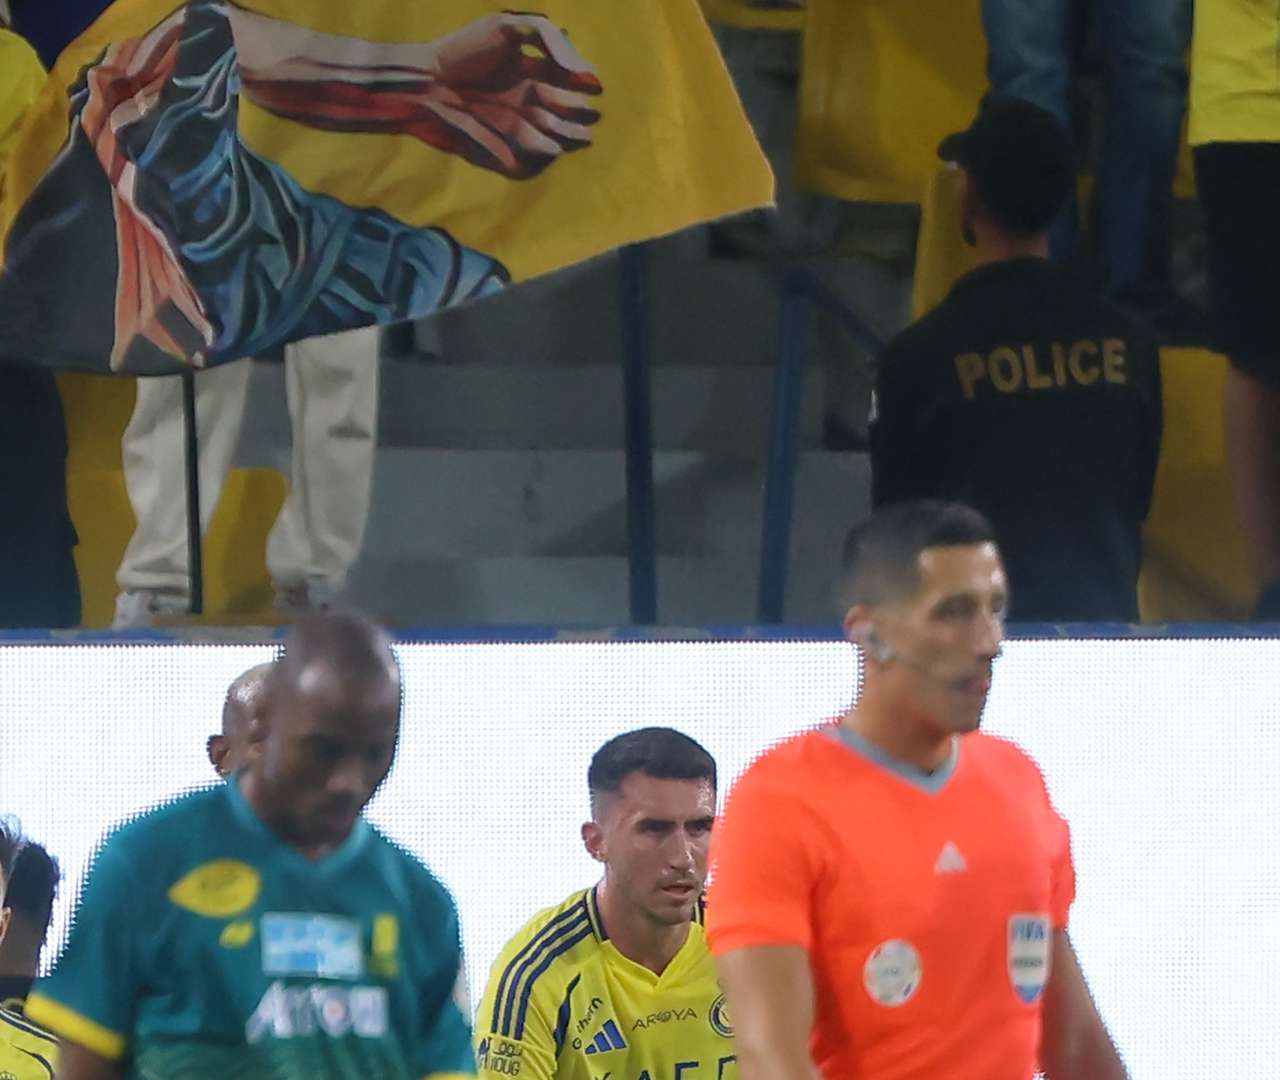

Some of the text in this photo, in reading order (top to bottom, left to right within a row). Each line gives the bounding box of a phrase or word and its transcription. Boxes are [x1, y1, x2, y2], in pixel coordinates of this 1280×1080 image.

[954, 337, 1129, 399] POLICE
[572, 996, 604, 1051] Gthern
[631, 1007, 697, 1032] AROYA
